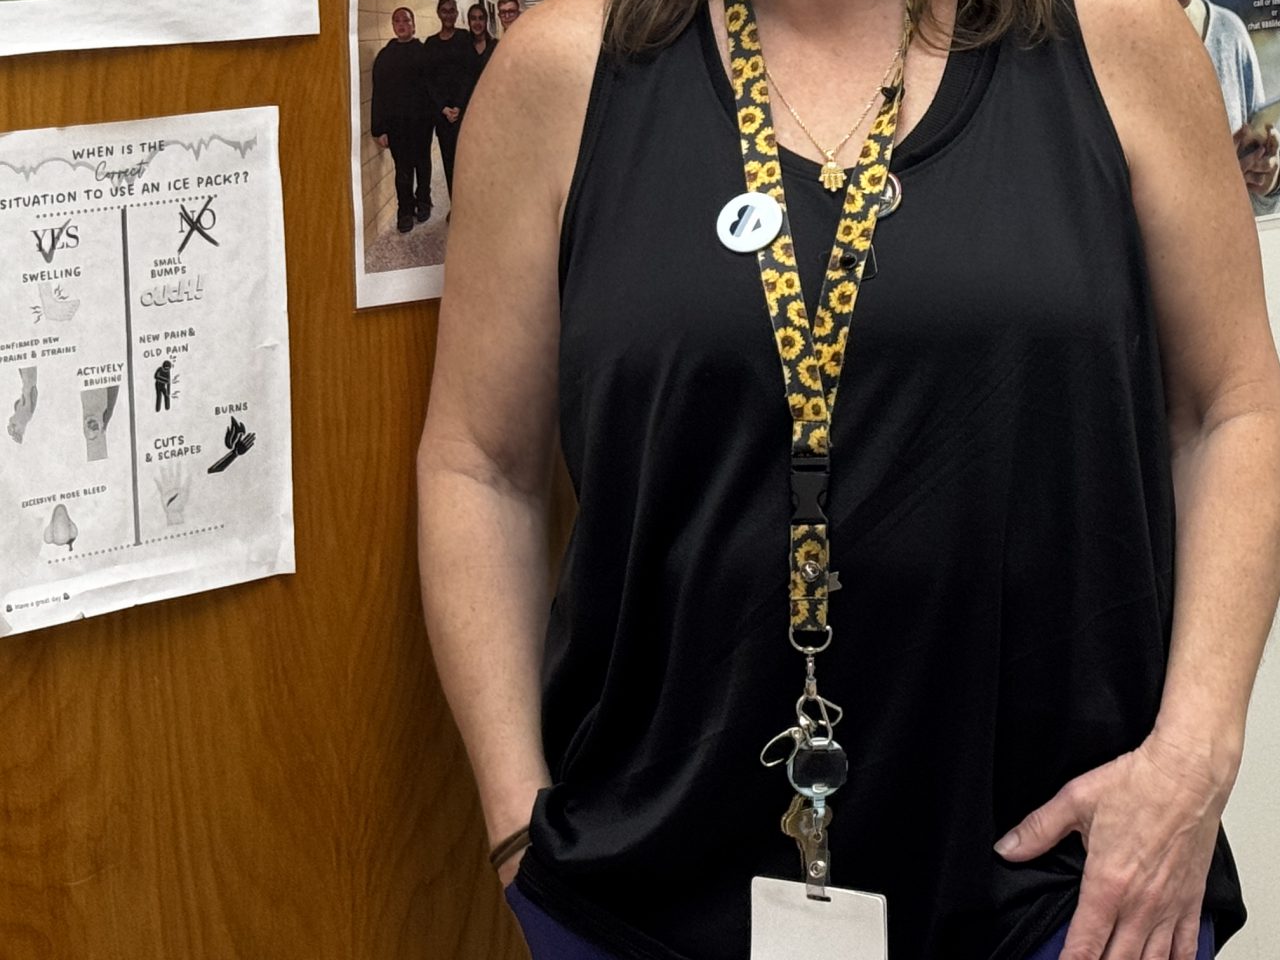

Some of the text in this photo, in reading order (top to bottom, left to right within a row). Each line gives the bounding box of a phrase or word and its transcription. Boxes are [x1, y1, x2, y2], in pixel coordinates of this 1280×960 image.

[1271, 8, 1278, 17] or
[72, 140, 166, 160] WHEN IS THE
[95, 160, 148, 182] Correct
[0, 171, 250, 210] SITUATION TO USE AN ICE PACK??
[178, 208, 217, 234] NO
[30, 225, 80, 252] YES
[153, 256, 182, 267] SMALL
[22, 267, 82, 283] SWELLING
[150, 265, 187, 279] BUMPS
[0, 338, 40, 351] ONFIRMED
[139, 334, 160, 345] NEW
[41, 346, 76, 357] STRAINS
[143, 342, 189, 359] OLD PAIN
[77, 363, 124, 376] ACTIVELY
[84, 374, 122, 387] BRUISING
[215, 402, 248, 415] BURNS
[154, 435, 185, 449] CUTS
[145, 445, 202, 463] & SCRAPES
[21, 485, 107, 509] EXCESSIVE NOSE BLEED
